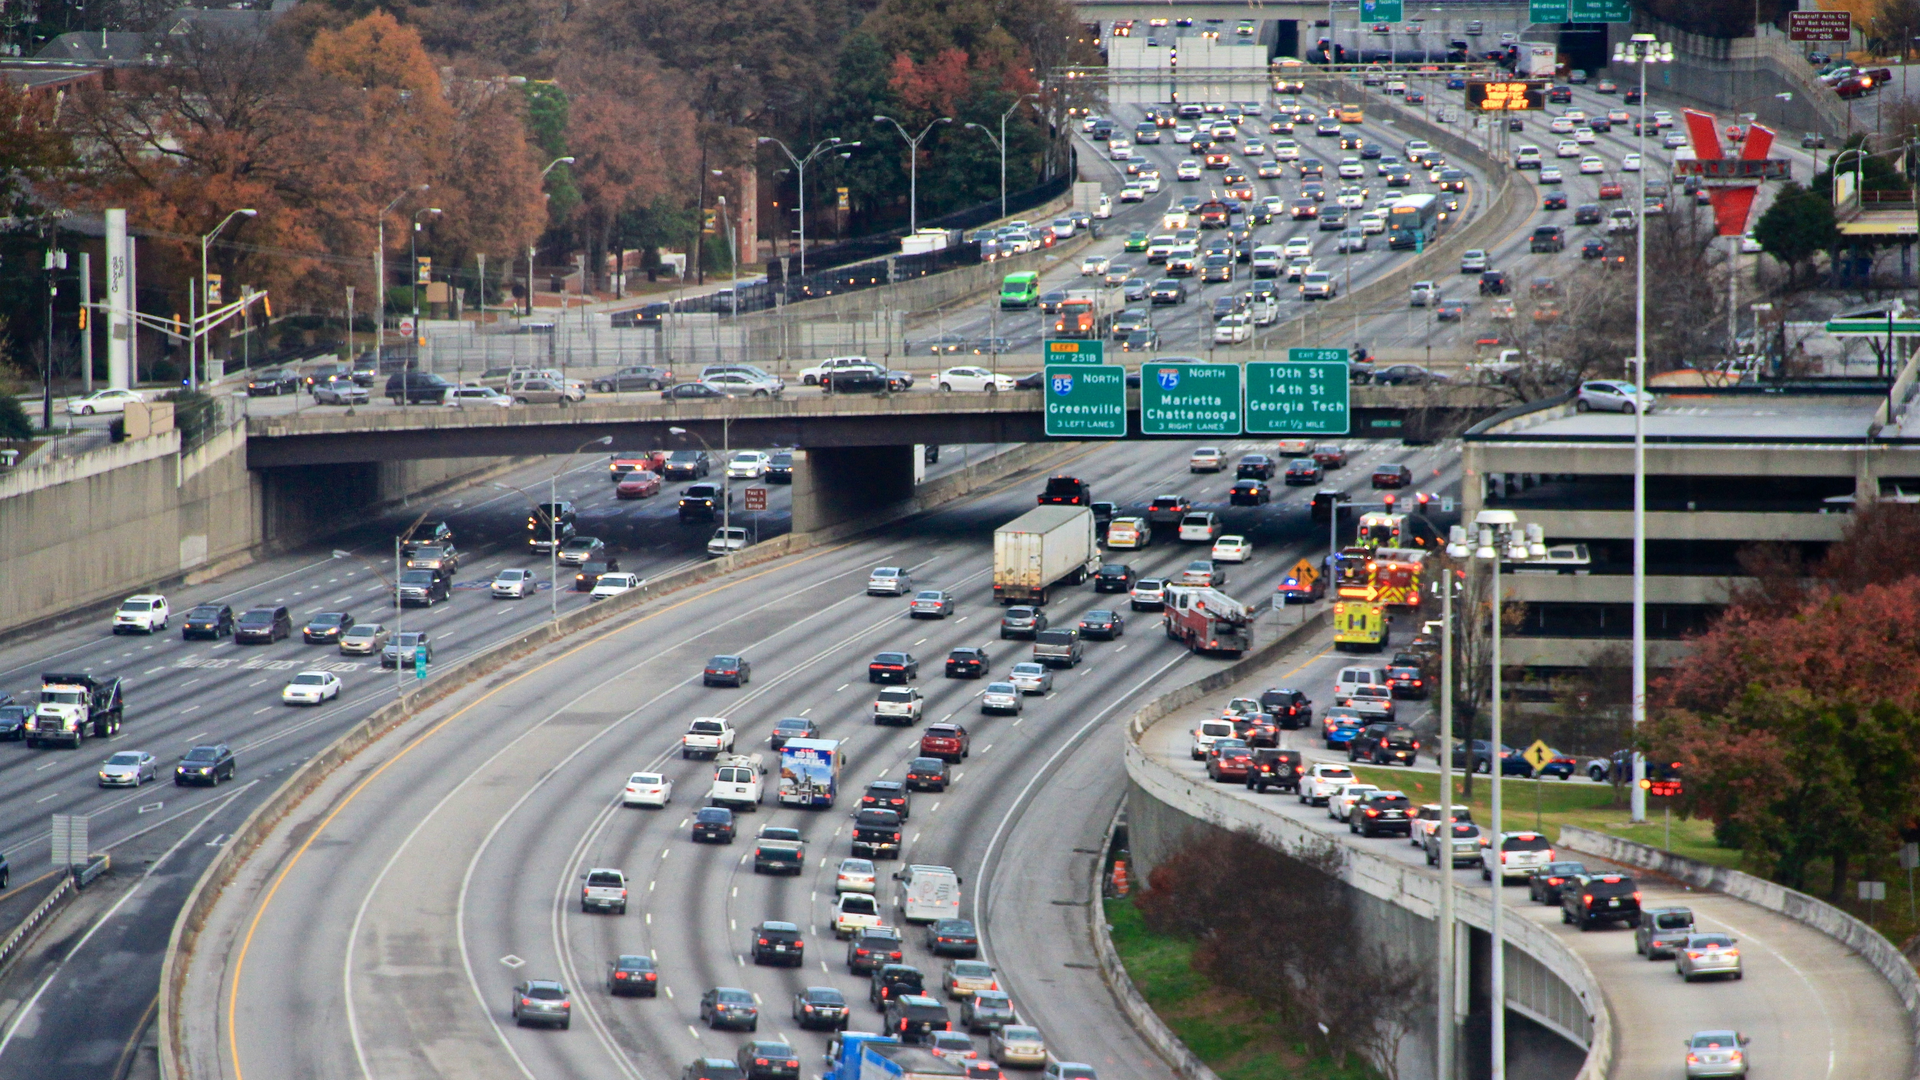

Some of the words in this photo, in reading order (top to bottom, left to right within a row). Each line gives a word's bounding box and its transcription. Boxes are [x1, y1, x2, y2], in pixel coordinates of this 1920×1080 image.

[1679, 162, 1785, 174] VARSITY
[111, 256, 119, 293] Georgia
[1071, 354, 1096, 362] 251B
[1317, 351, 1339, 360] 250
[1160, 373, 1178, 386] 75
[1189, 368, 1225, 378] NORTH
[1270, 367, 1302, 378] 10th
[1309, 367, 1324, 379] St
[1053, 379, 1072, 392] 85
[1083, 373, 1119, 383] NORTH
[1269, 384, 1303, 395] 14th
[1310, 384, 1324, 395] St
[1161, 395, 1221, 406] Marietta
[1049, 403, 1121, 414] Greenville
[1250, 400, 1304, 414] Georgia
[1312, 400, 1344, 412] Tech
[1146, 409, 1236, 422] Chattanooga
[1065, 420, 1085, 428] LEFT
